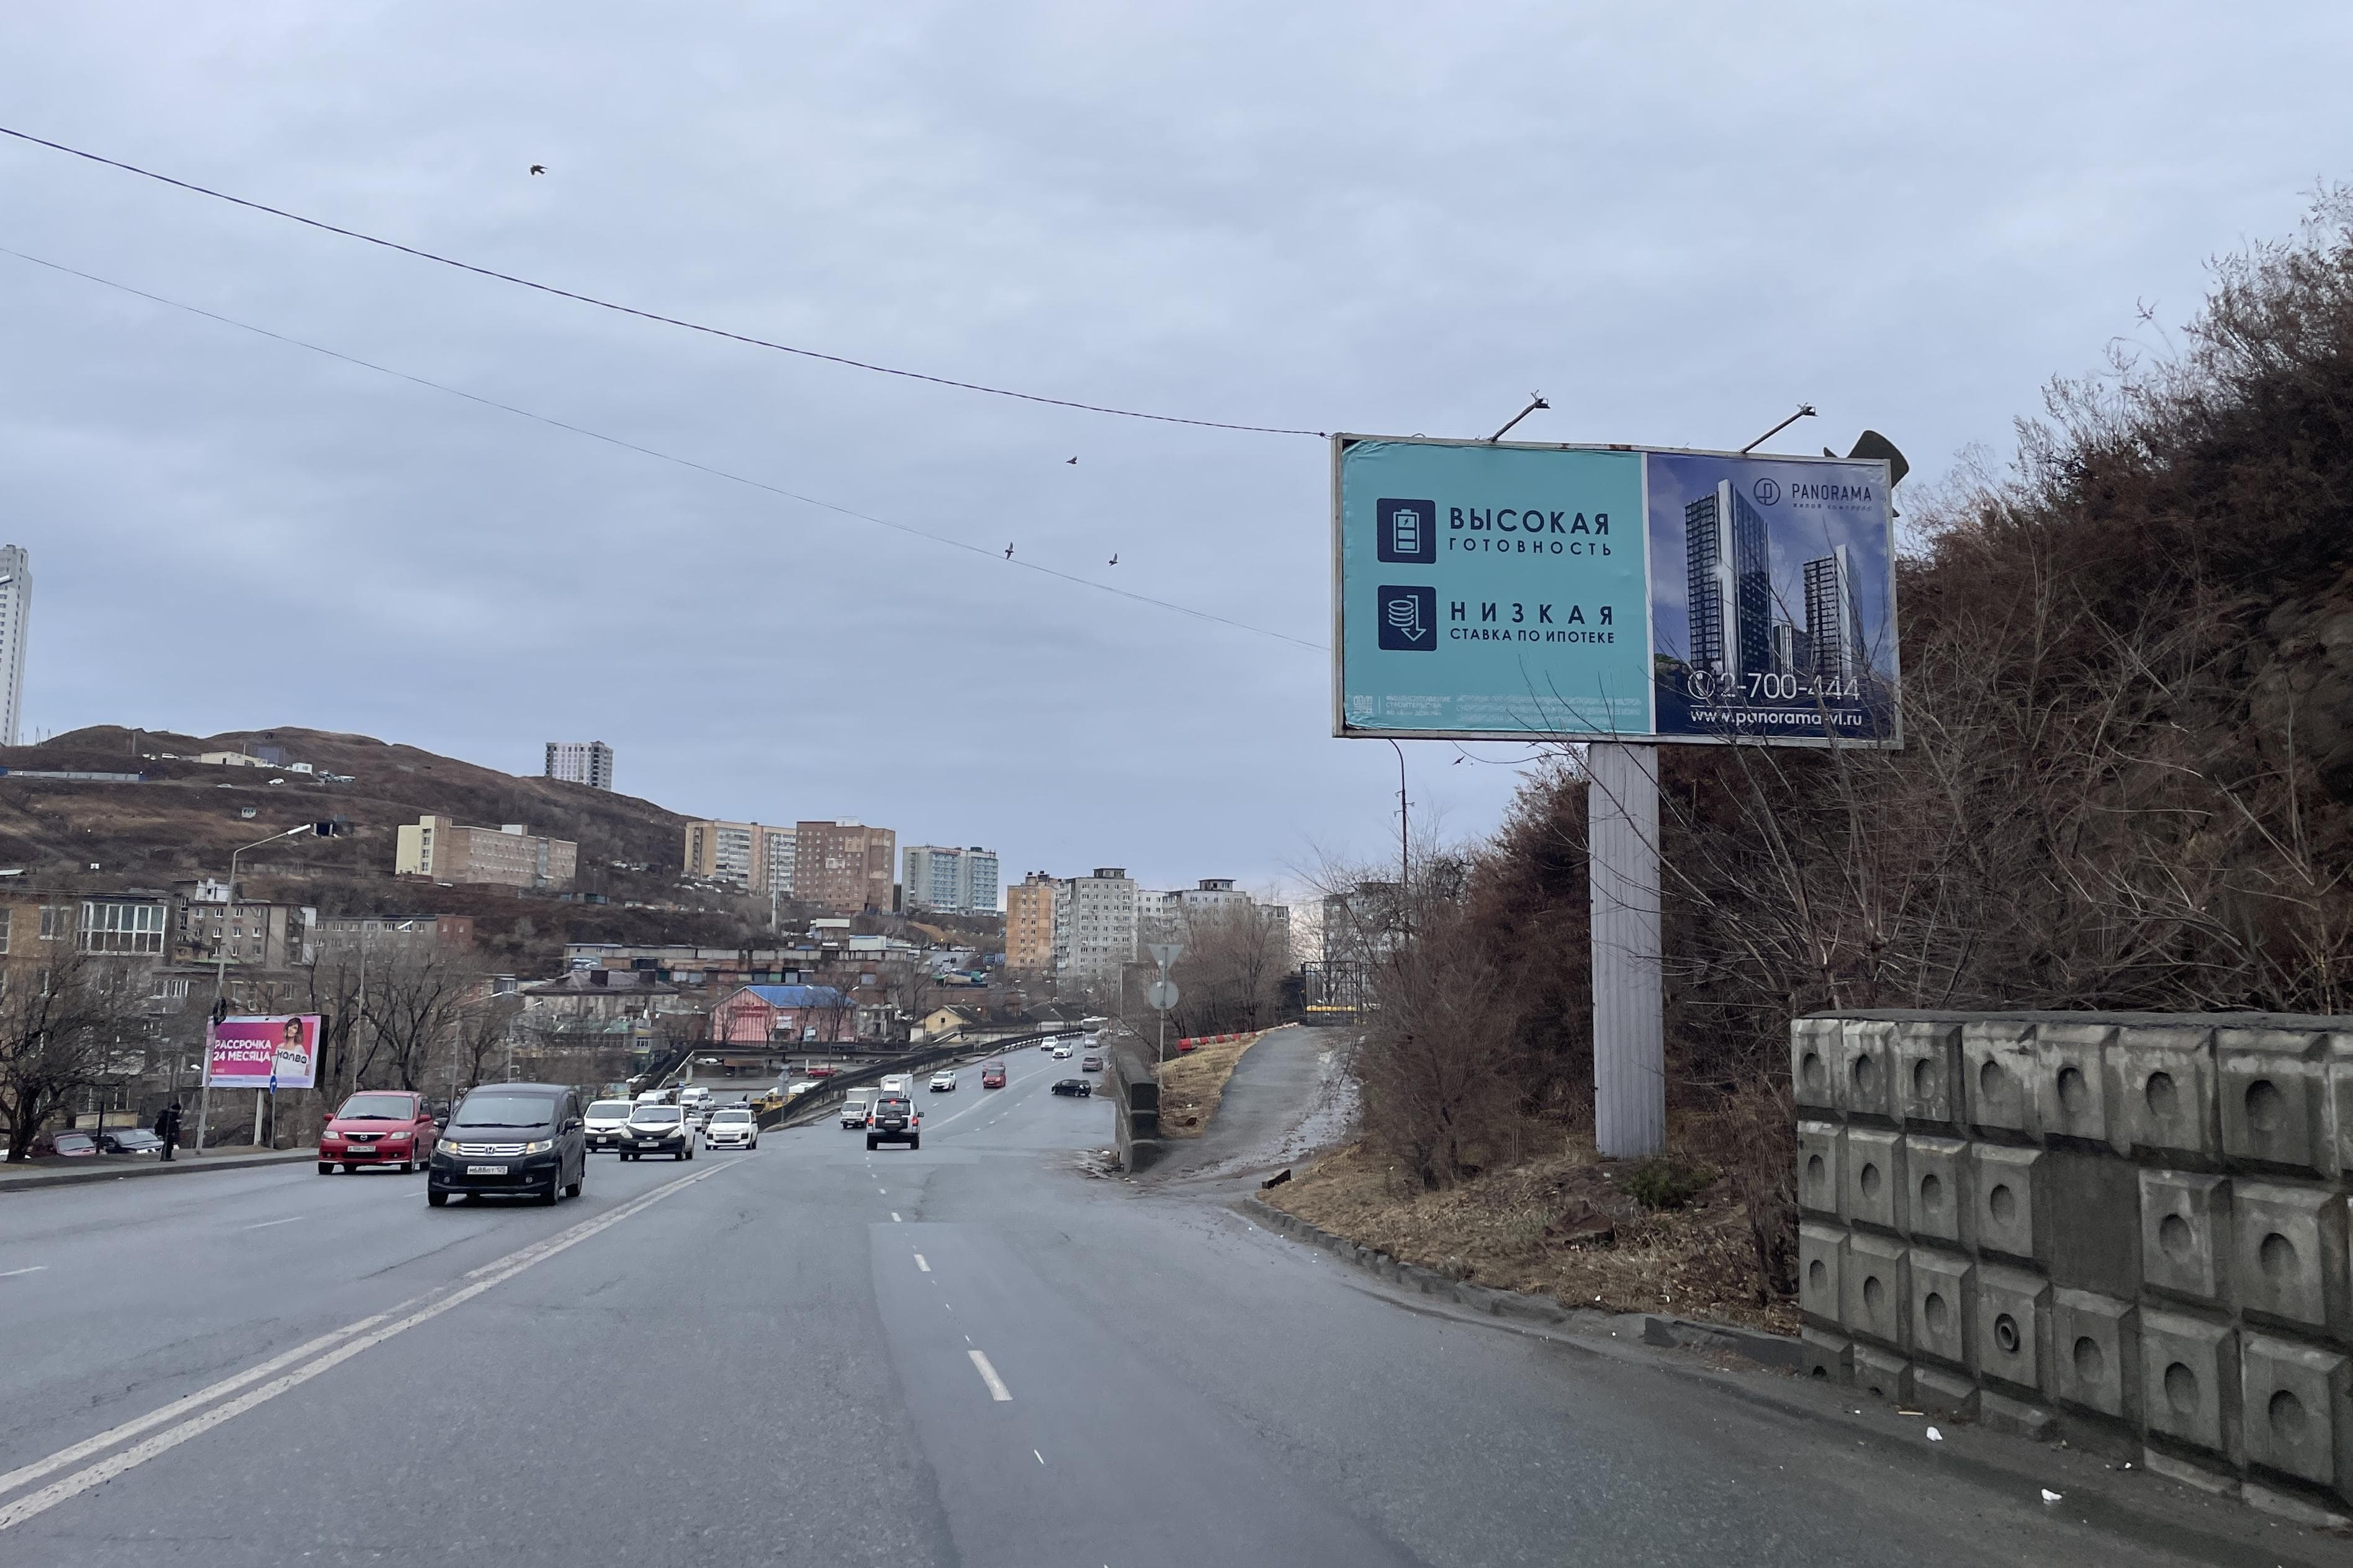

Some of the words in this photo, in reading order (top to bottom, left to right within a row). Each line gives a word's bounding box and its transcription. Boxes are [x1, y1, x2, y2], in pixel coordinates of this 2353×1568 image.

[1792, 483, 1873, 502] PANORAMA
[1449, 507, 1609, 535] ВЫСОКАЯ
[1449, 537, 1611, 556] ГОТОВНОСТЬ
[1451, 601, 1613, 625] НИЗКАЯ
[1450, 628, 1512, 641] СТАВКА
[1518, 630, 1540, 642] ПО
[1546, 630, 1614, 644] ИПОТЕКЕ
[1720, 673, 1860, 701] 2-700-444
[214, 1039, 272, 1050] РАССРОЧКА
[213, 1051, 226, 1062] 24
[227, 1051, 271, 1063] МЕСЯЦА
